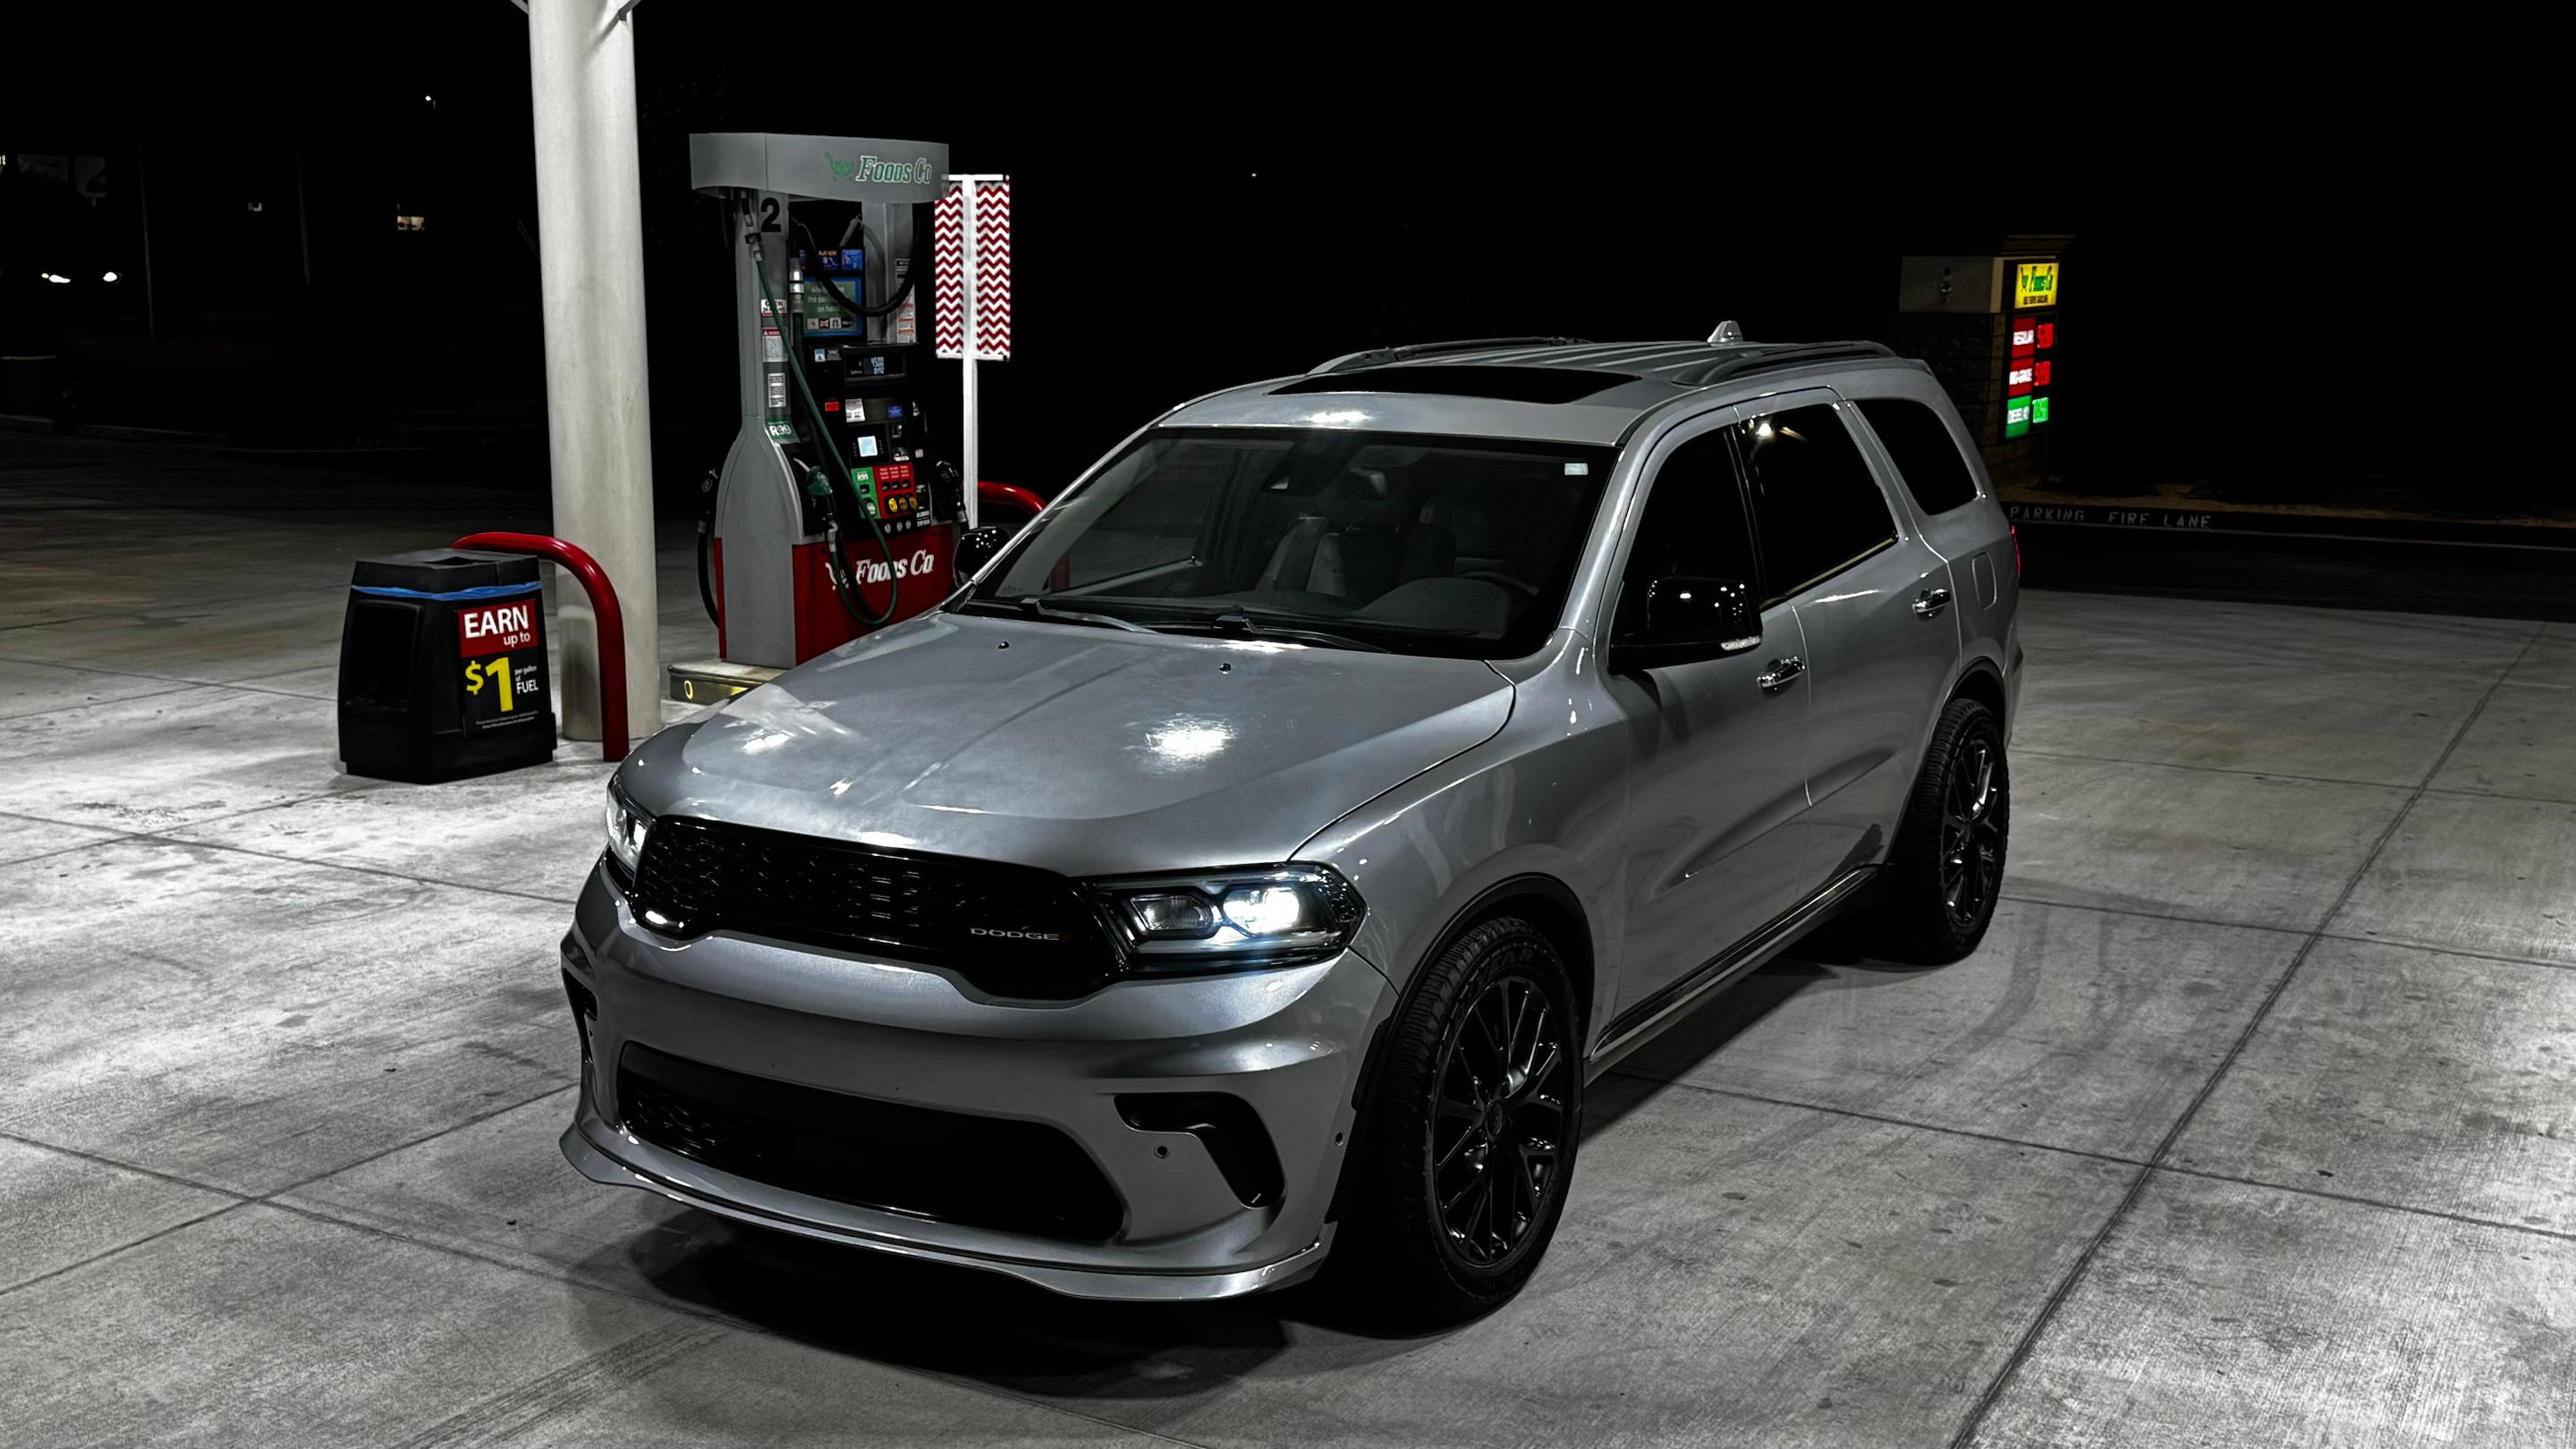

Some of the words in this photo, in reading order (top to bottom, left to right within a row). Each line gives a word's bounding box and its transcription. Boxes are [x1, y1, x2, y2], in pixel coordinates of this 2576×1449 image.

[760, 197, 782, 233] 2
[769, 424, 792, 436] R99
[2010, 506, 2085, 521] PARKING
[2108, 511, 2150, 525] FIRE
[2164, 514, 2212, 529] LANE
[463, 605, 529, 639] EARN
[504, 635, 518, 648] up
[520, 631, 530, 642] to
[465, 657, 513, 712] $1
[516, 679, 538, 694] FUEL
[970, 928, 1060, 941] DODGE
